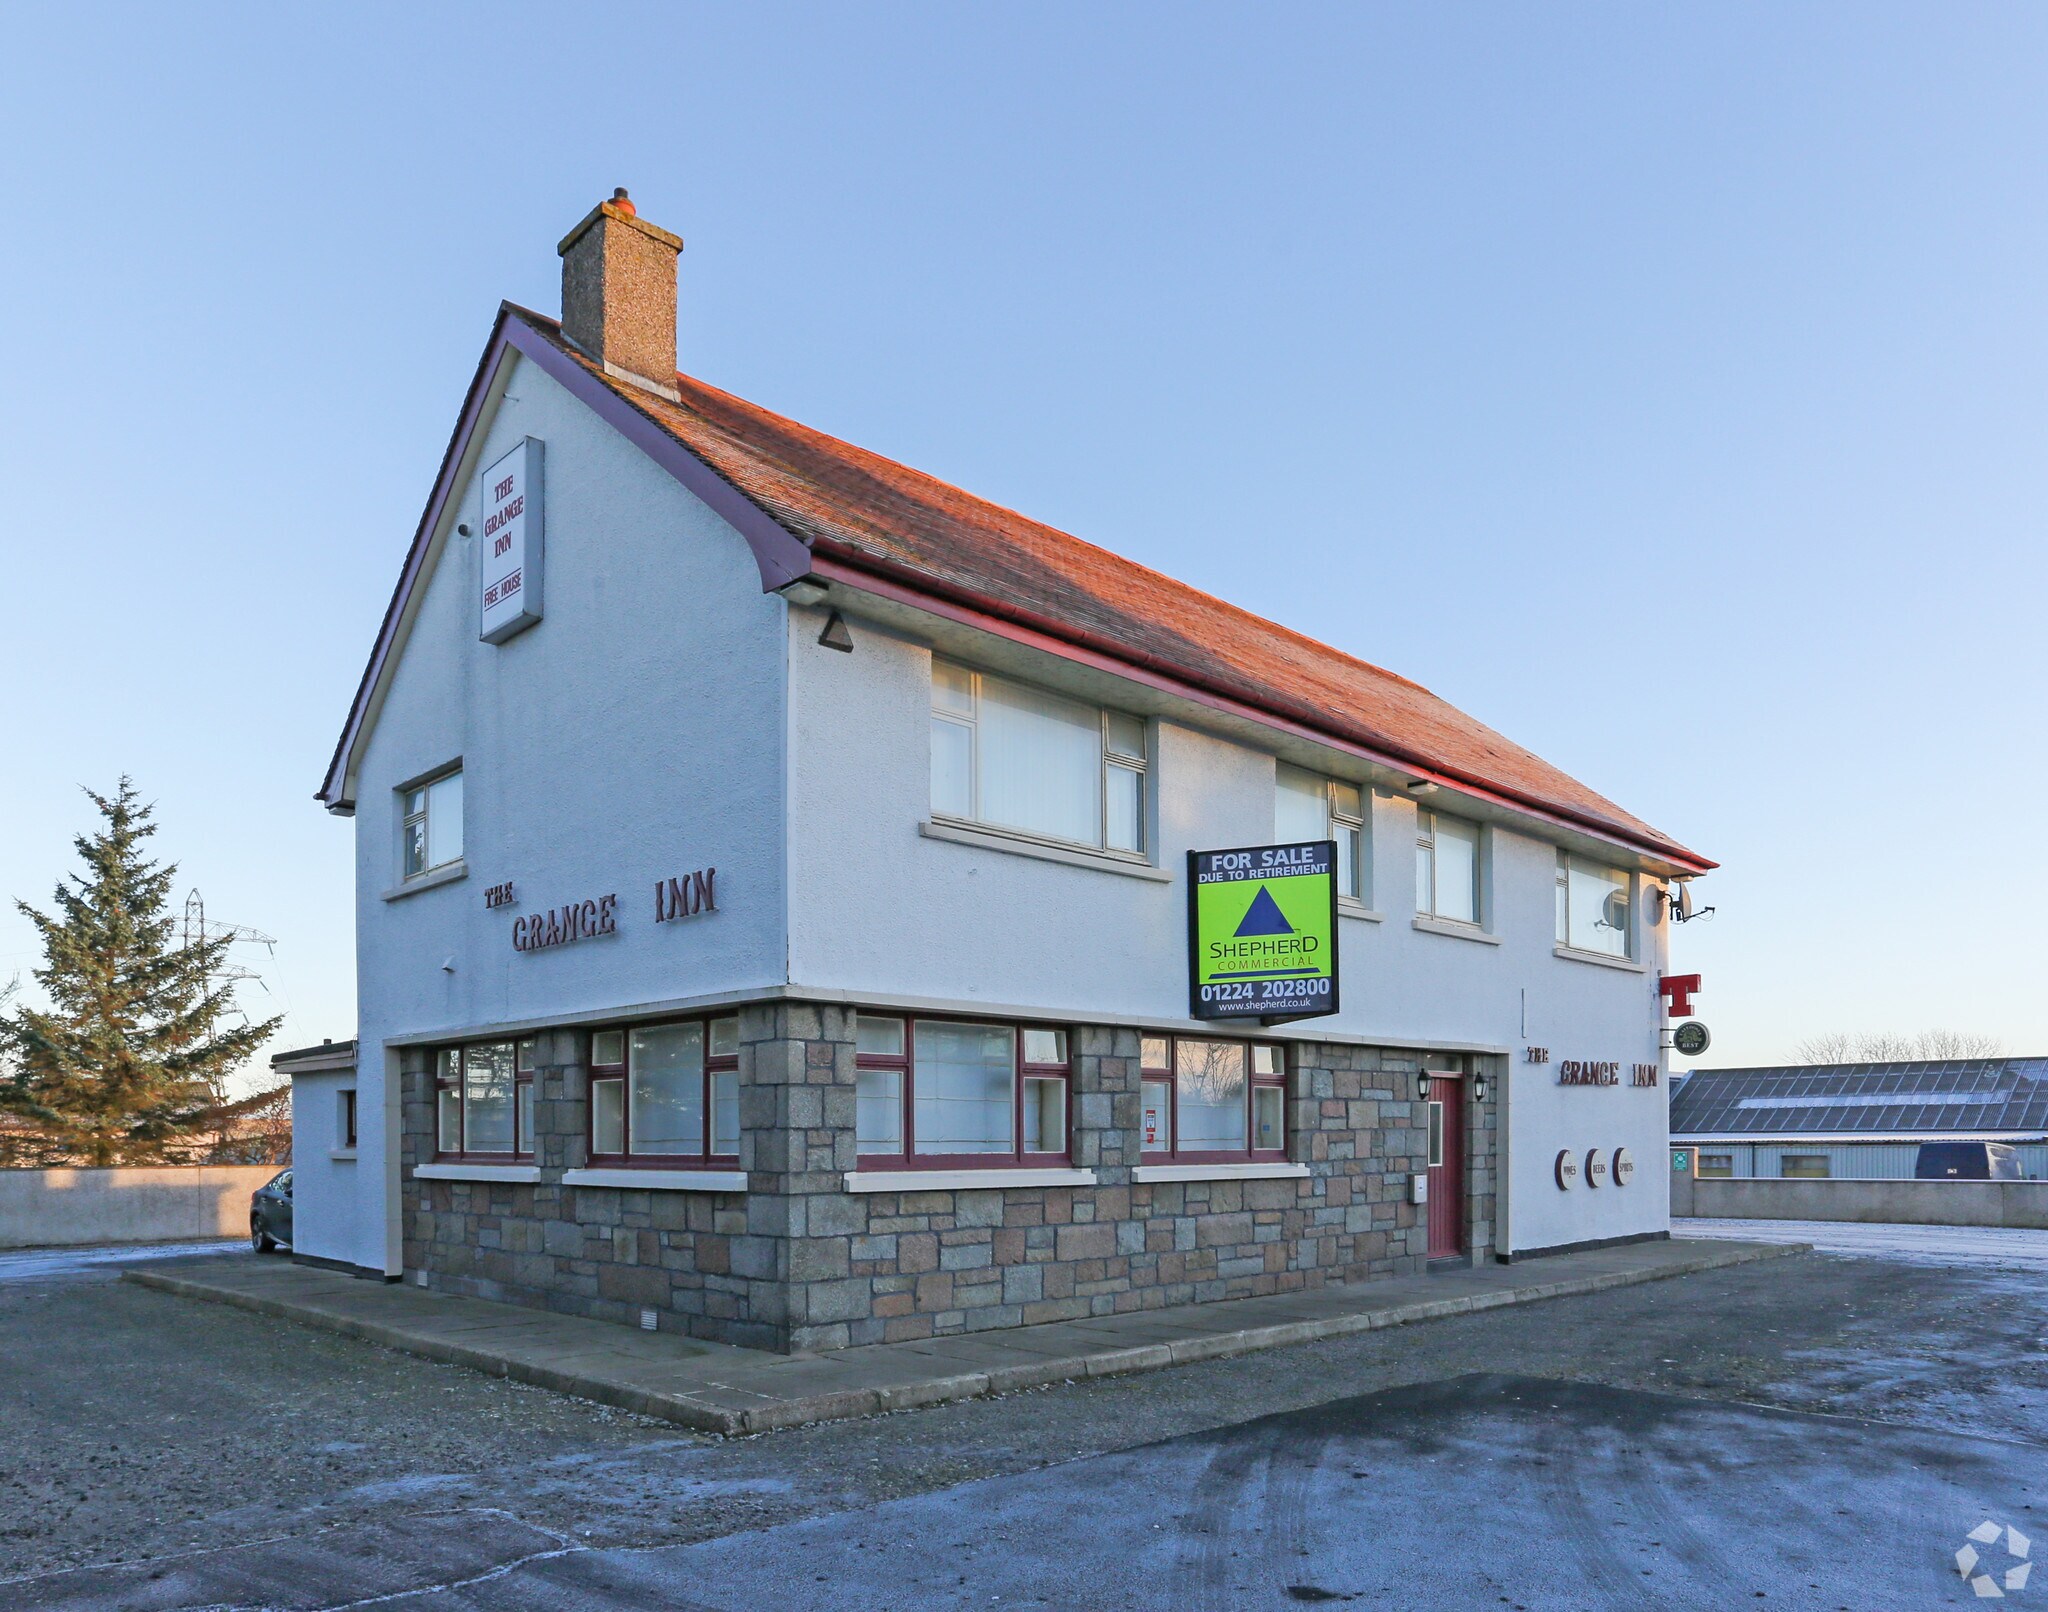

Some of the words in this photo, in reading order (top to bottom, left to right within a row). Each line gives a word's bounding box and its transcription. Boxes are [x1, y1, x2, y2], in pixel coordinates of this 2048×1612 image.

[495, 475, 513, 503] THE
[485, 495, 523, 537] GRANGE
[495, 531, 511, 558] INN
[484, 589, 499, 607] FREE
[501, 572, 521, 595] HOUSE
[1211, 853, 1251, 870] FOR
[1261, 847, 1314, 867] SALE
[1199, 873, 1223, 882] DUE
[1228, 870, 1244, 880] TO
[1249, 863, 1327, 879] RETIREMENT
[484, 881, 513, 908] THE
[513, 893, 616, 952] GRANGE
[655, 867, 716, 923] INN
[1210, 936, 1318, 958] SHEPHERD
[1218, 956, 1313, 971] COMMERCIAL
[1201, 984, 1254, 1001] 01224
[1262, 978, 1330, 998] 202800
[1660, 974, 1701, 1017] T
[1218, 997, 1311, 1011] www.shepherd.co.uk
[1527, 1046, 1549, 1063] THE
[1560, 1060, 1618, 1086] GRANGE
[1632, 1063, 1657, 1086] INN
